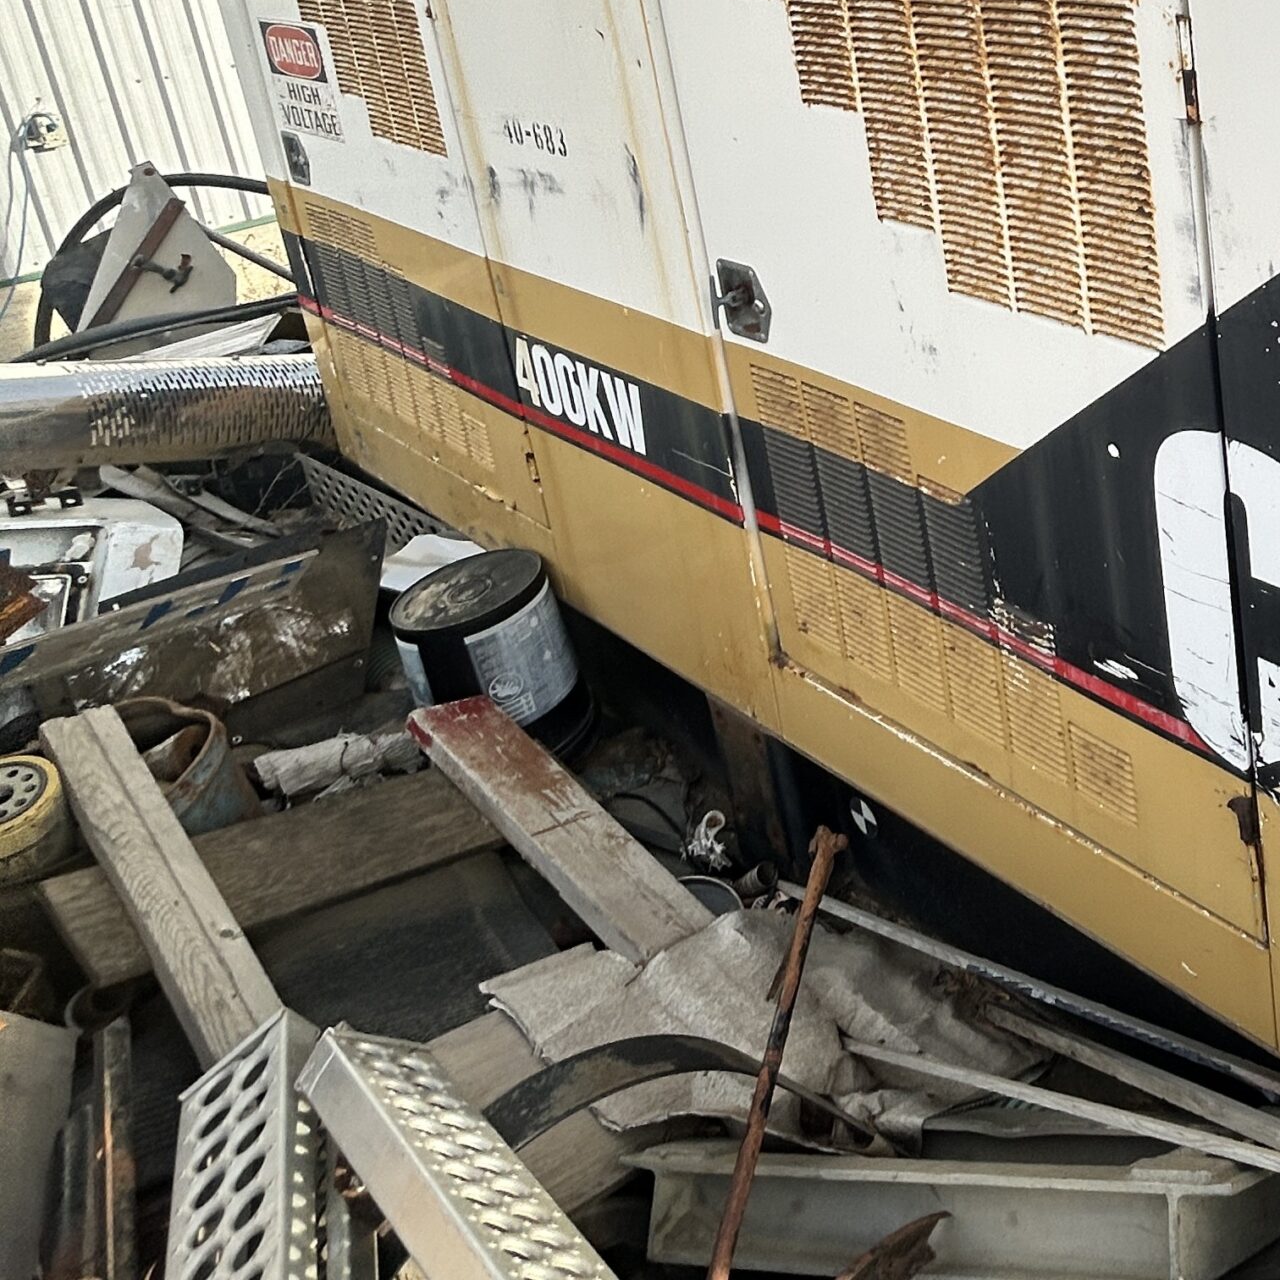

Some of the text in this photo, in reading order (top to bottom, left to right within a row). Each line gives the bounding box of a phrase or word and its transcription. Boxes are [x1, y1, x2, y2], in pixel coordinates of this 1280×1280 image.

[268, 36, 318, 69] DANGER
[286, 81, 321, 106] HIGH
[281, 102, 341, 136] VOLTAGE
[515, 334, 647, 456] 400KW
